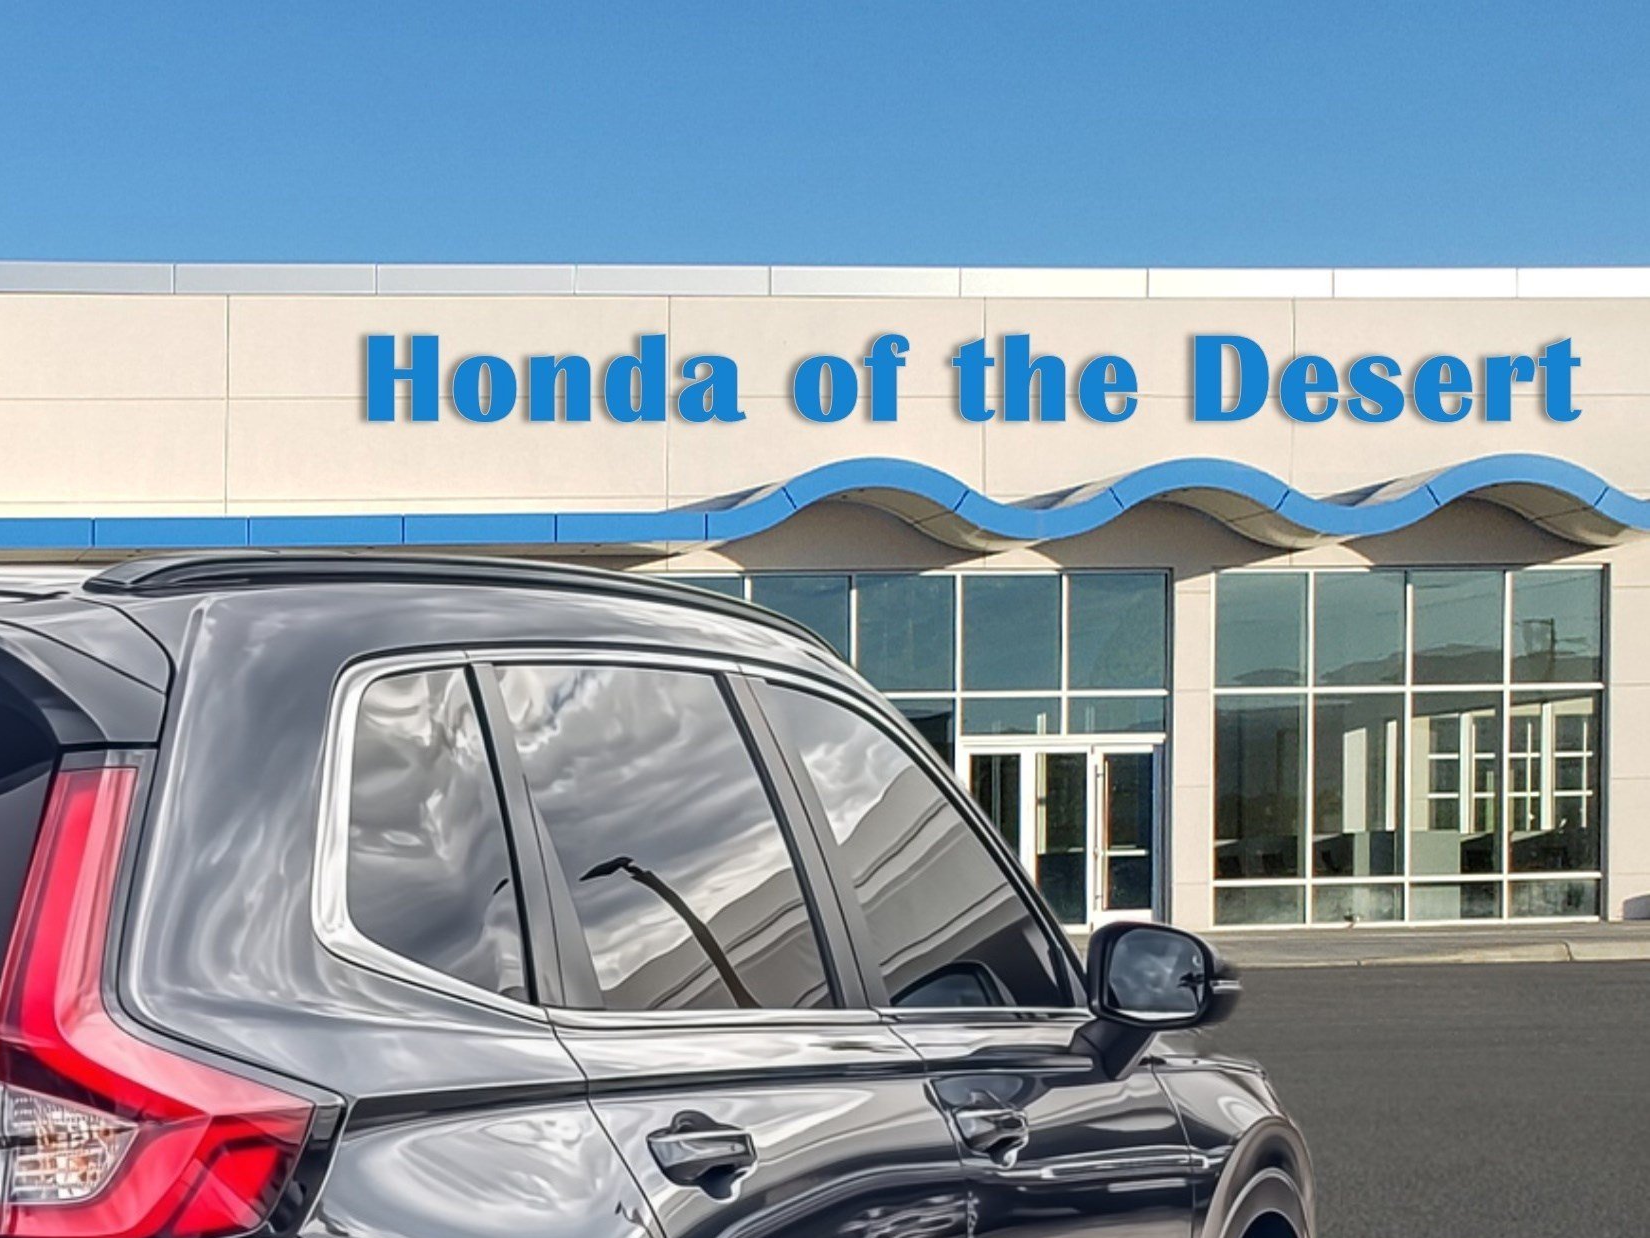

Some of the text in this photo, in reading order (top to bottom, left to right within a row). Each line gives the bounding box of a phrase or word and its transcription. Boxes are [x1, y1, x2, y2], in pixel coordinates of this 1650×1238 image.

[366, 333, 1582, 423] Honda of the Desert
